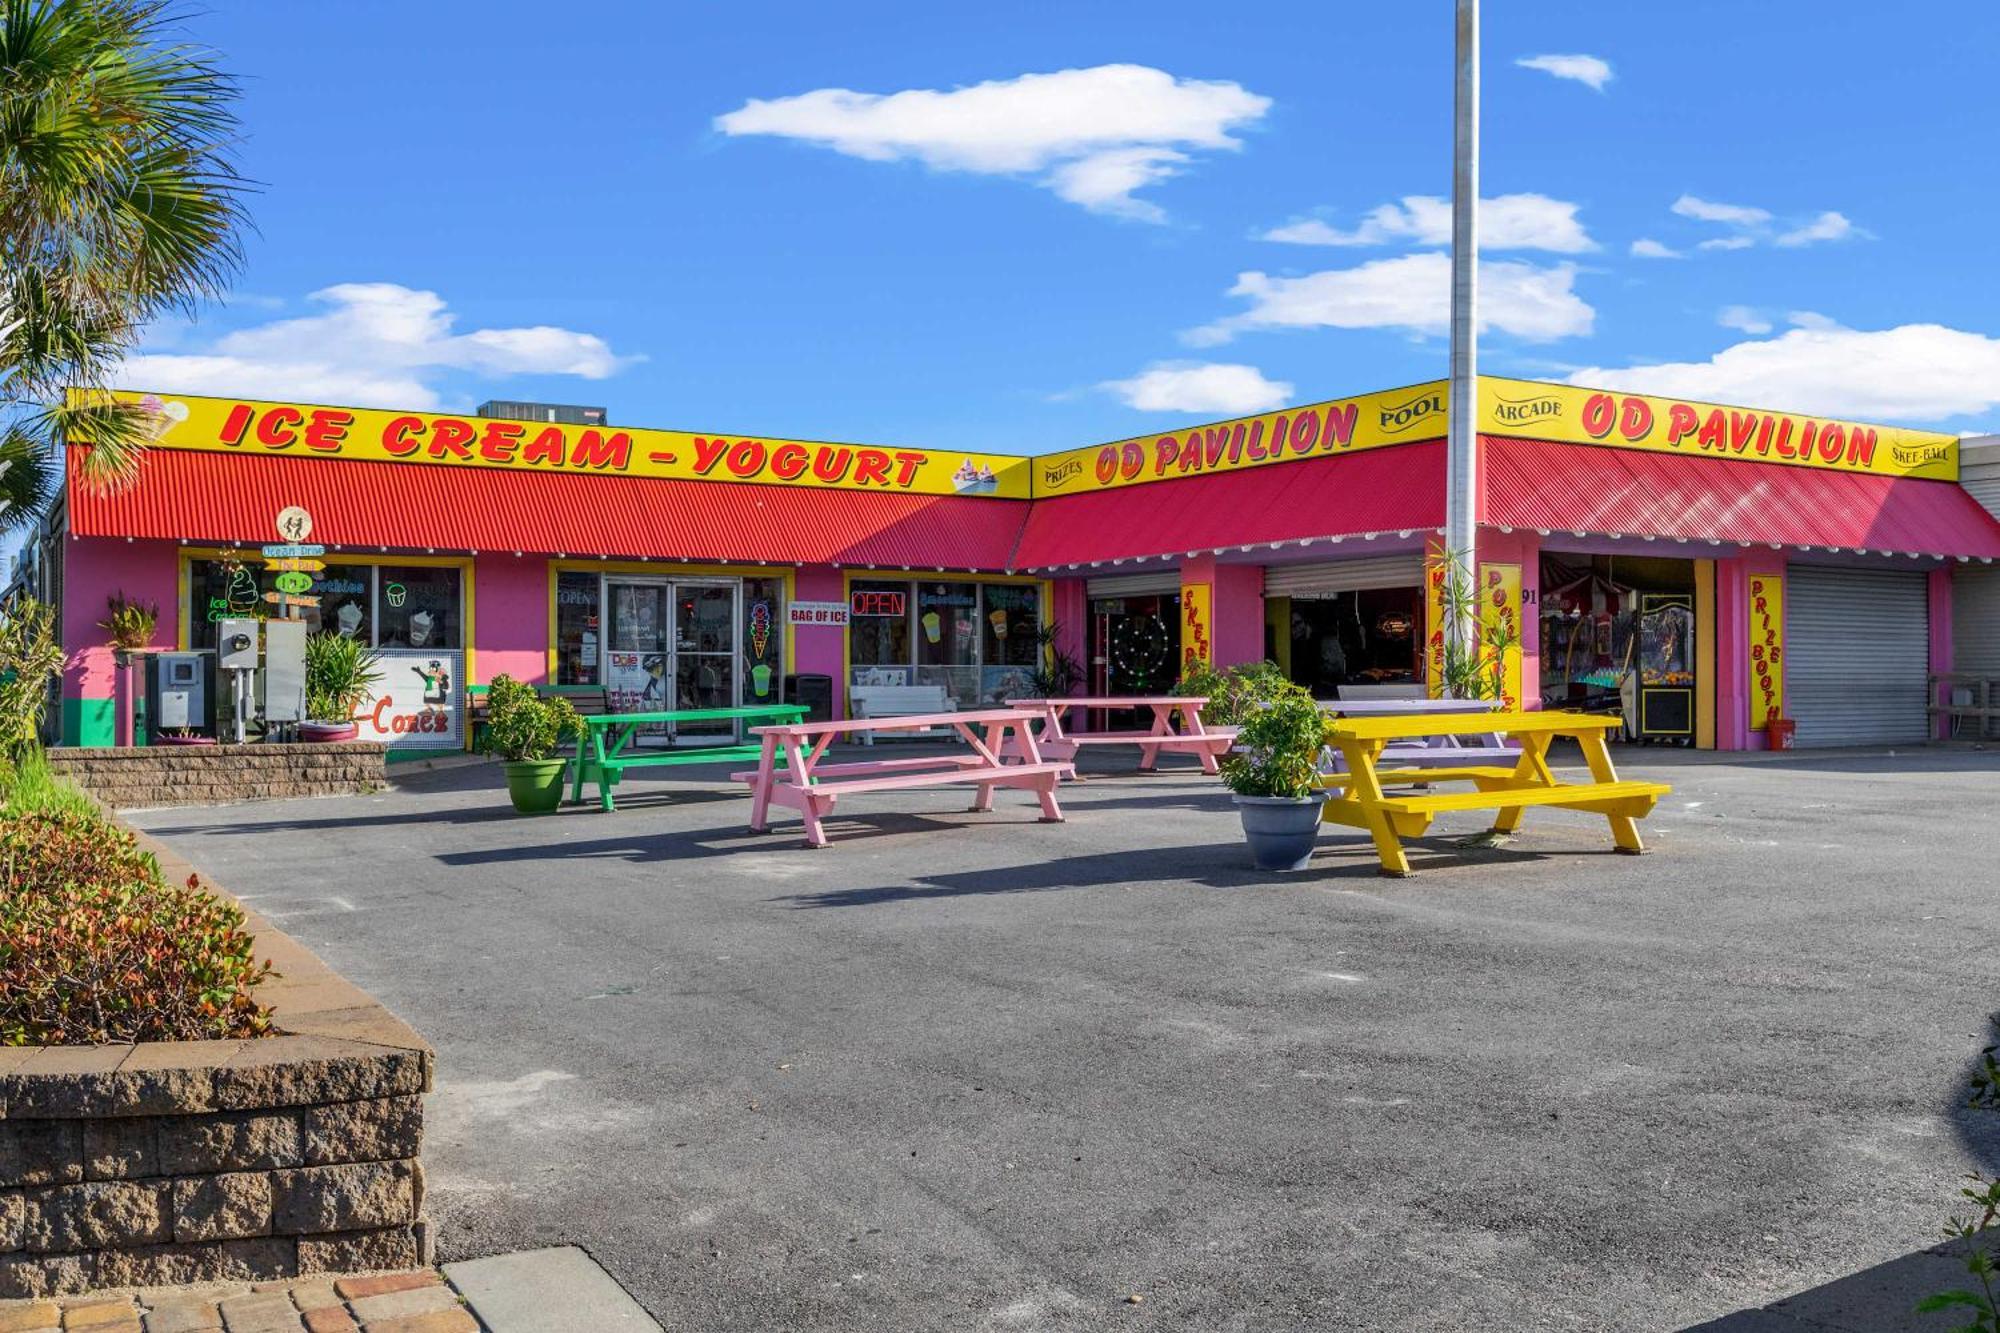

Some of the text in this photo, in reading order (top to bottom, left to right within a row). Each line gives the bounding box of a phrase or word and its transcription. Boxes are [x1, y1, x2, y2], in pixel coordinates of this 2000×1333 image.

[1381, 396, 1447, 427] POOL
[1495, 401, 1563, 421] ARCADE
[1582, 394, 1878, 466] OD PAVILION
[219, 404, 356, 452] ICE
[382, 415, 632, 472] CREAM
[692, 436, 928, 488] YOGURT
[1095, 403, 1359, 485] OD PAVILION
[1892, 447, 1949, 463] SKEE-BALL
[1045, 461, 1082, 483] PRIZES
[853, 594, 903, 614] OPEN
[1522, 589, 1536, 604] 91
[791, 609, 847, 622] BAG OF ICE
[1752, 580, 1781, 663] PRIZE
[1752, 645, 1780, 720] BOOTH
